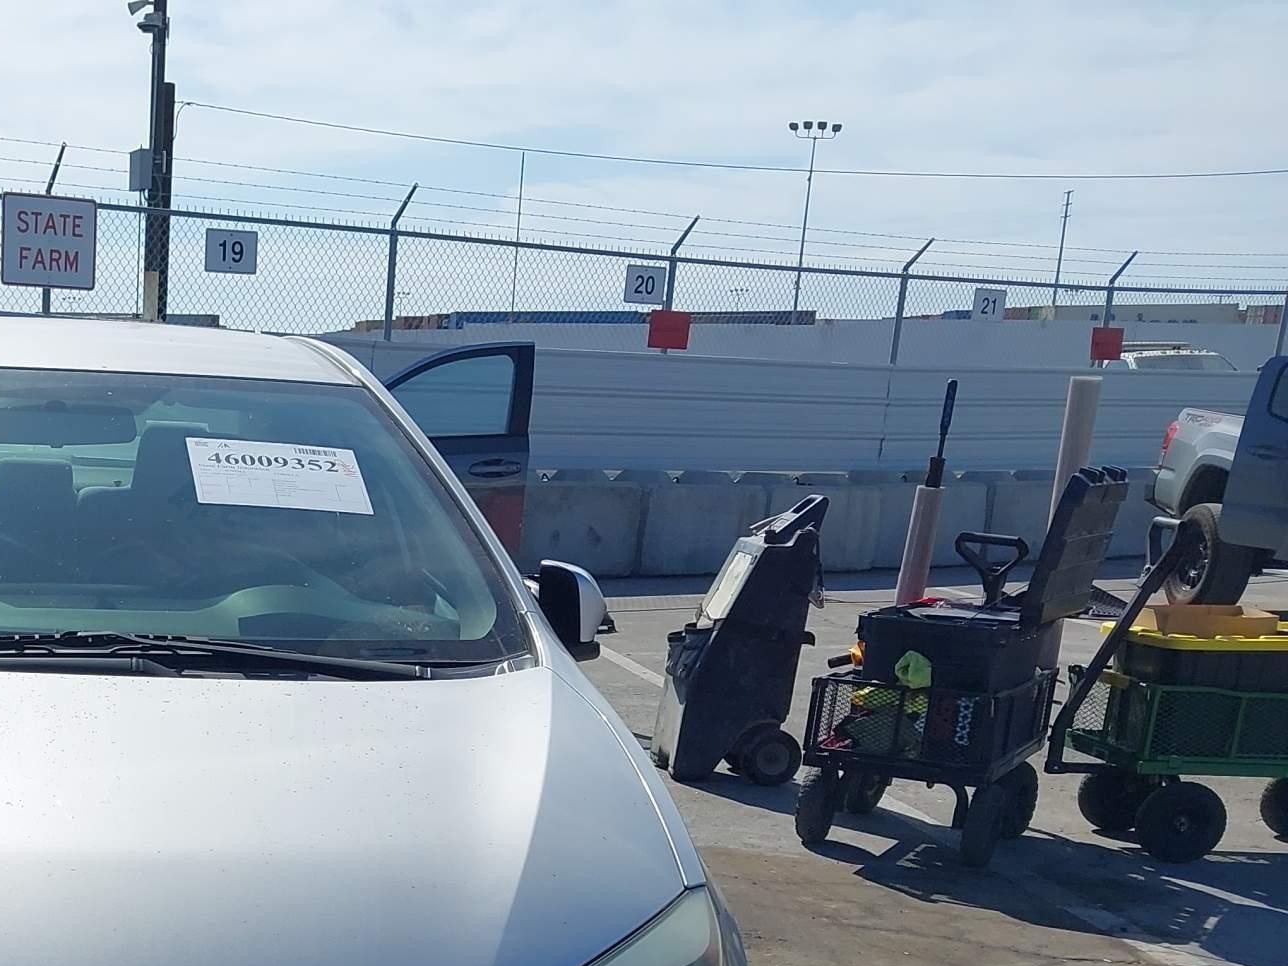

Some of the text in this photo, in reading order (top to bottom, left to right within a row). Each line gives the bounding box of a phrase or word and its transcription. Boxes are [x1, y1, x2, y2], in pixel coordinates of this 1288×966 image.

[15, 210, 85, 239] STATE
[17, 247, 81, 273] FARM
[218, 240, 245, 264] 19
[633, 274, 657, 296] 20
[980, 297, 999, 316] 21
[207, 452, 340, 474] 46009352
